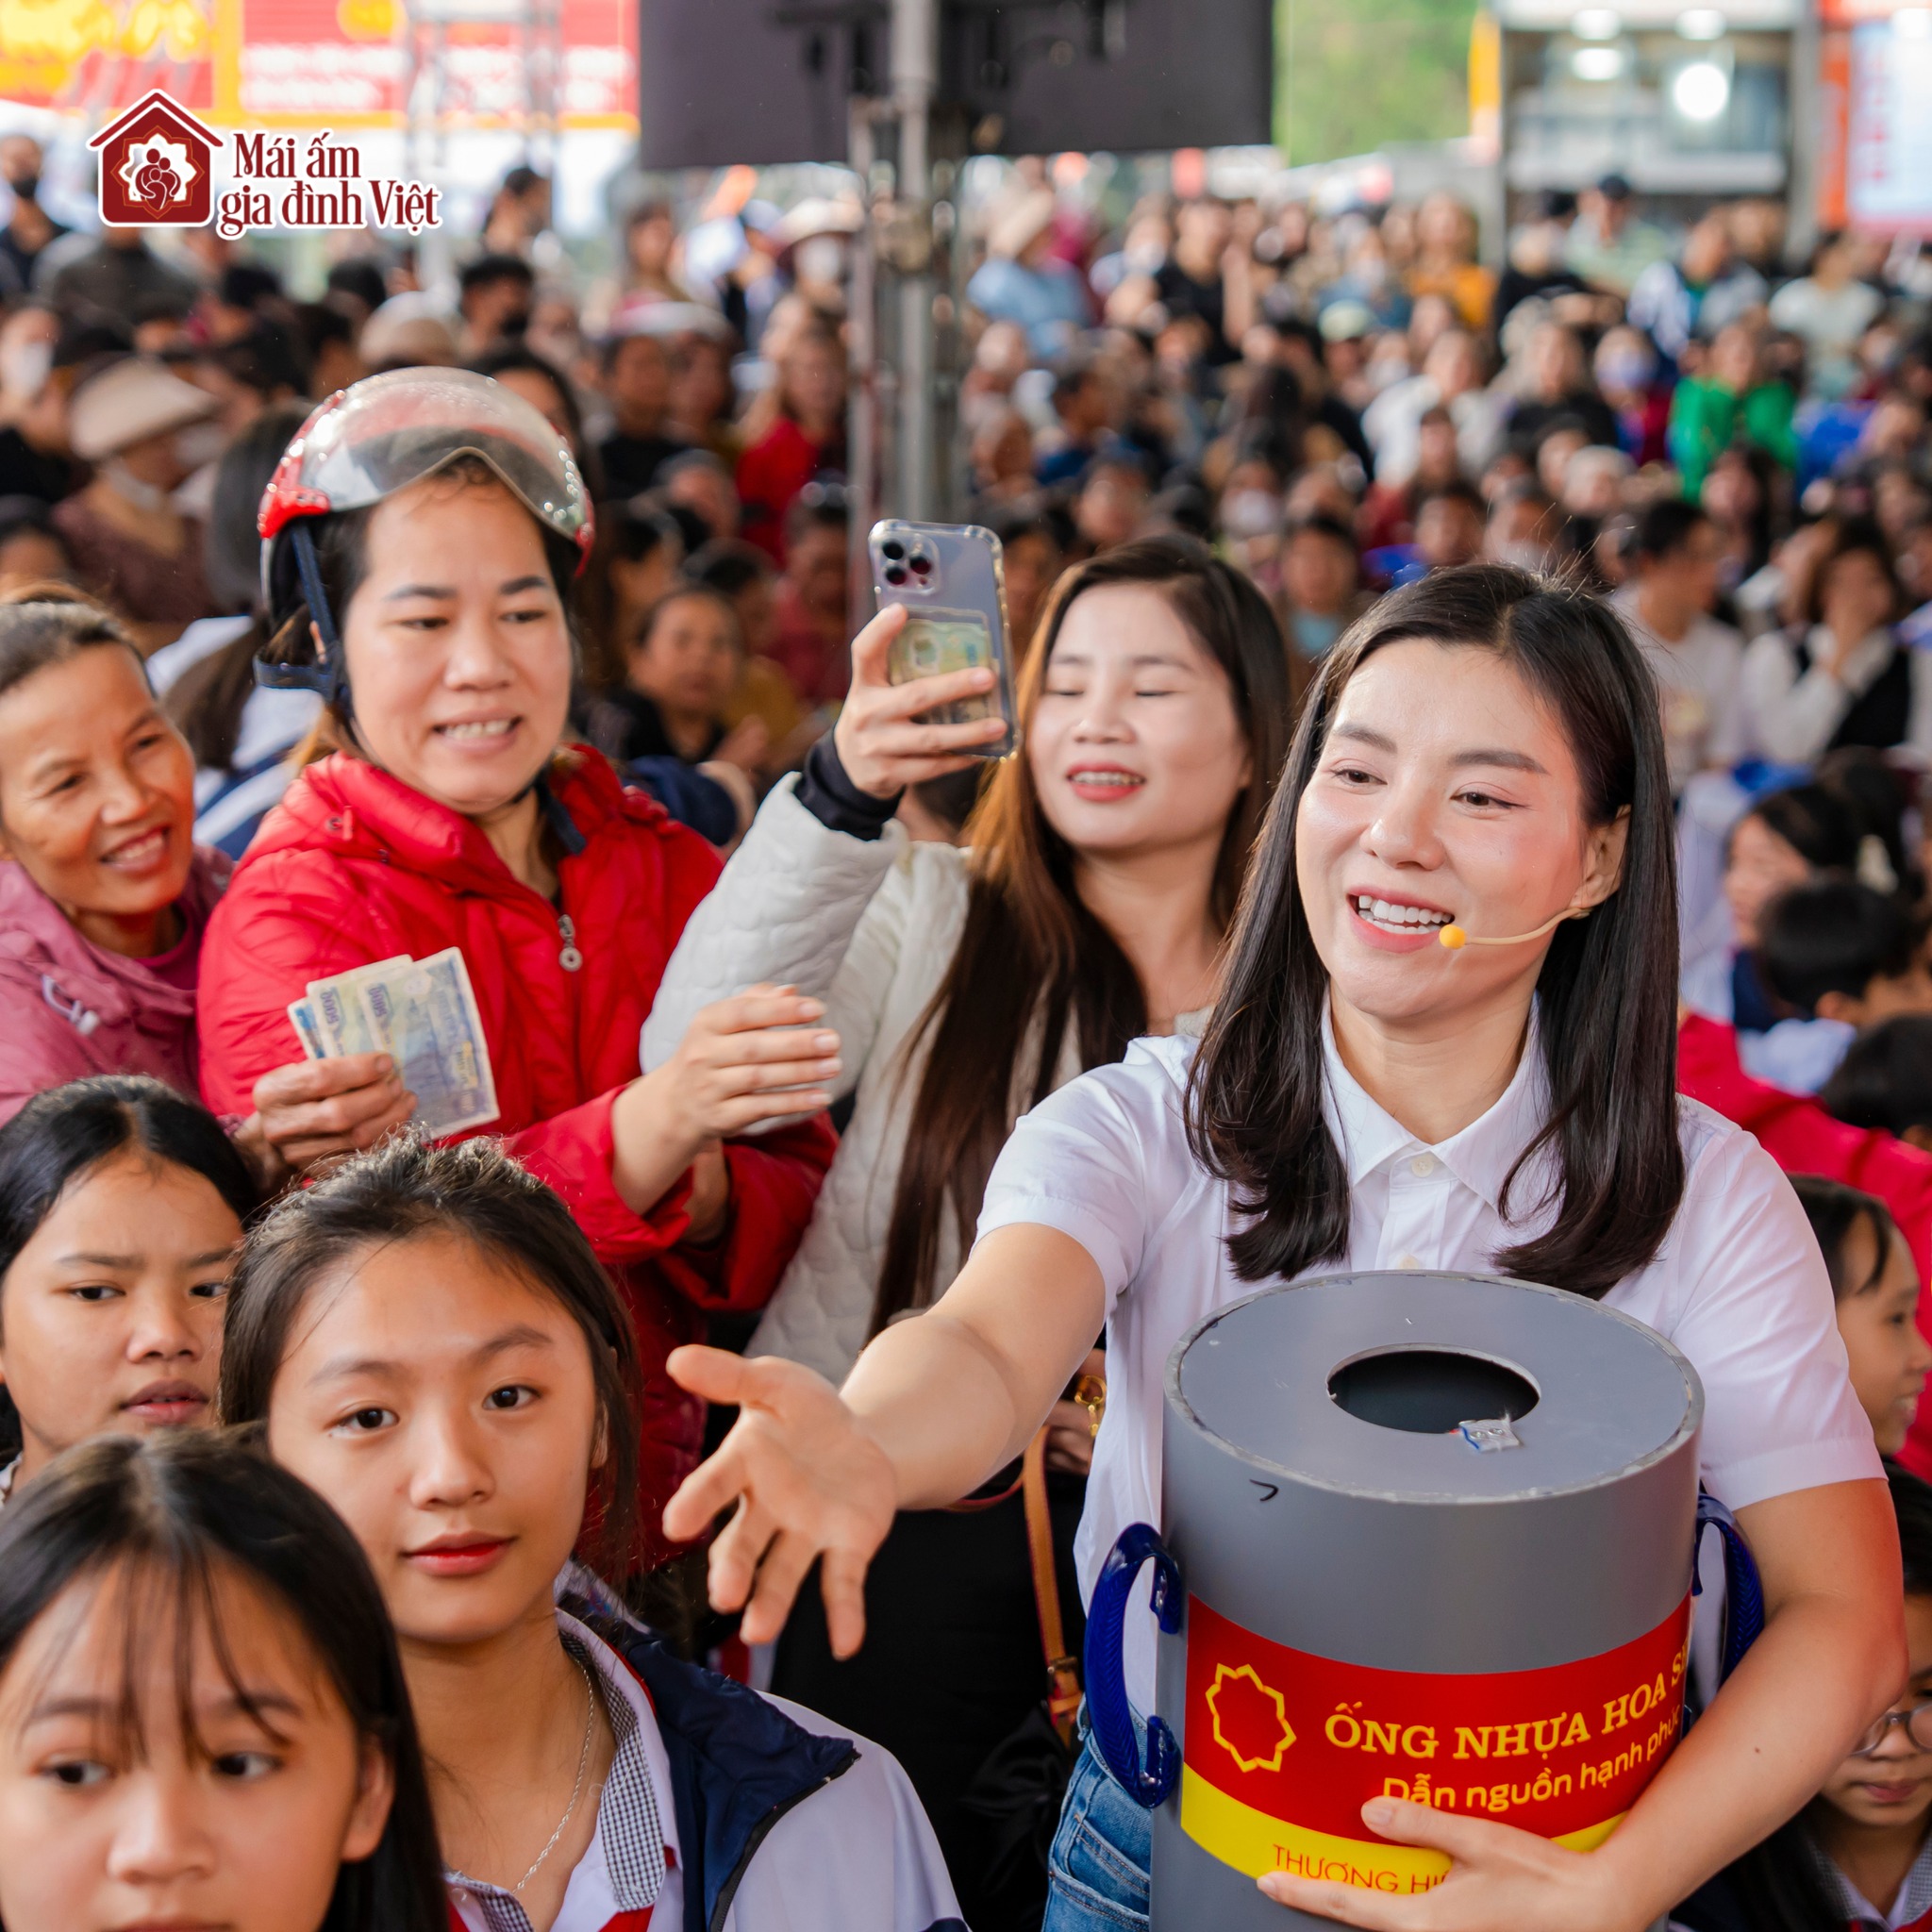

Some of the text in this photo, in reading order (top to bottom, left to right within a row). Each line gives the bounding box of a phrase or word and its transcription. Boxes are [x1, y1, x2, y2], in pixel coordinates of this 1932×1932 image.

[1324, 1701, 1440, 1759] ỐNG
[1453, 1711, 1591, 1760] NHỰA
[1601, 1672, 1667, 1734] HOA
[1383, 1773, 1456, 1808] Dẫn
[1466, 1767, 1573, 1812] nguồn
[1579, 1741, 1643, 1790] hạnh
[1274, 1843, 1398, 1892] THƯƠNG
